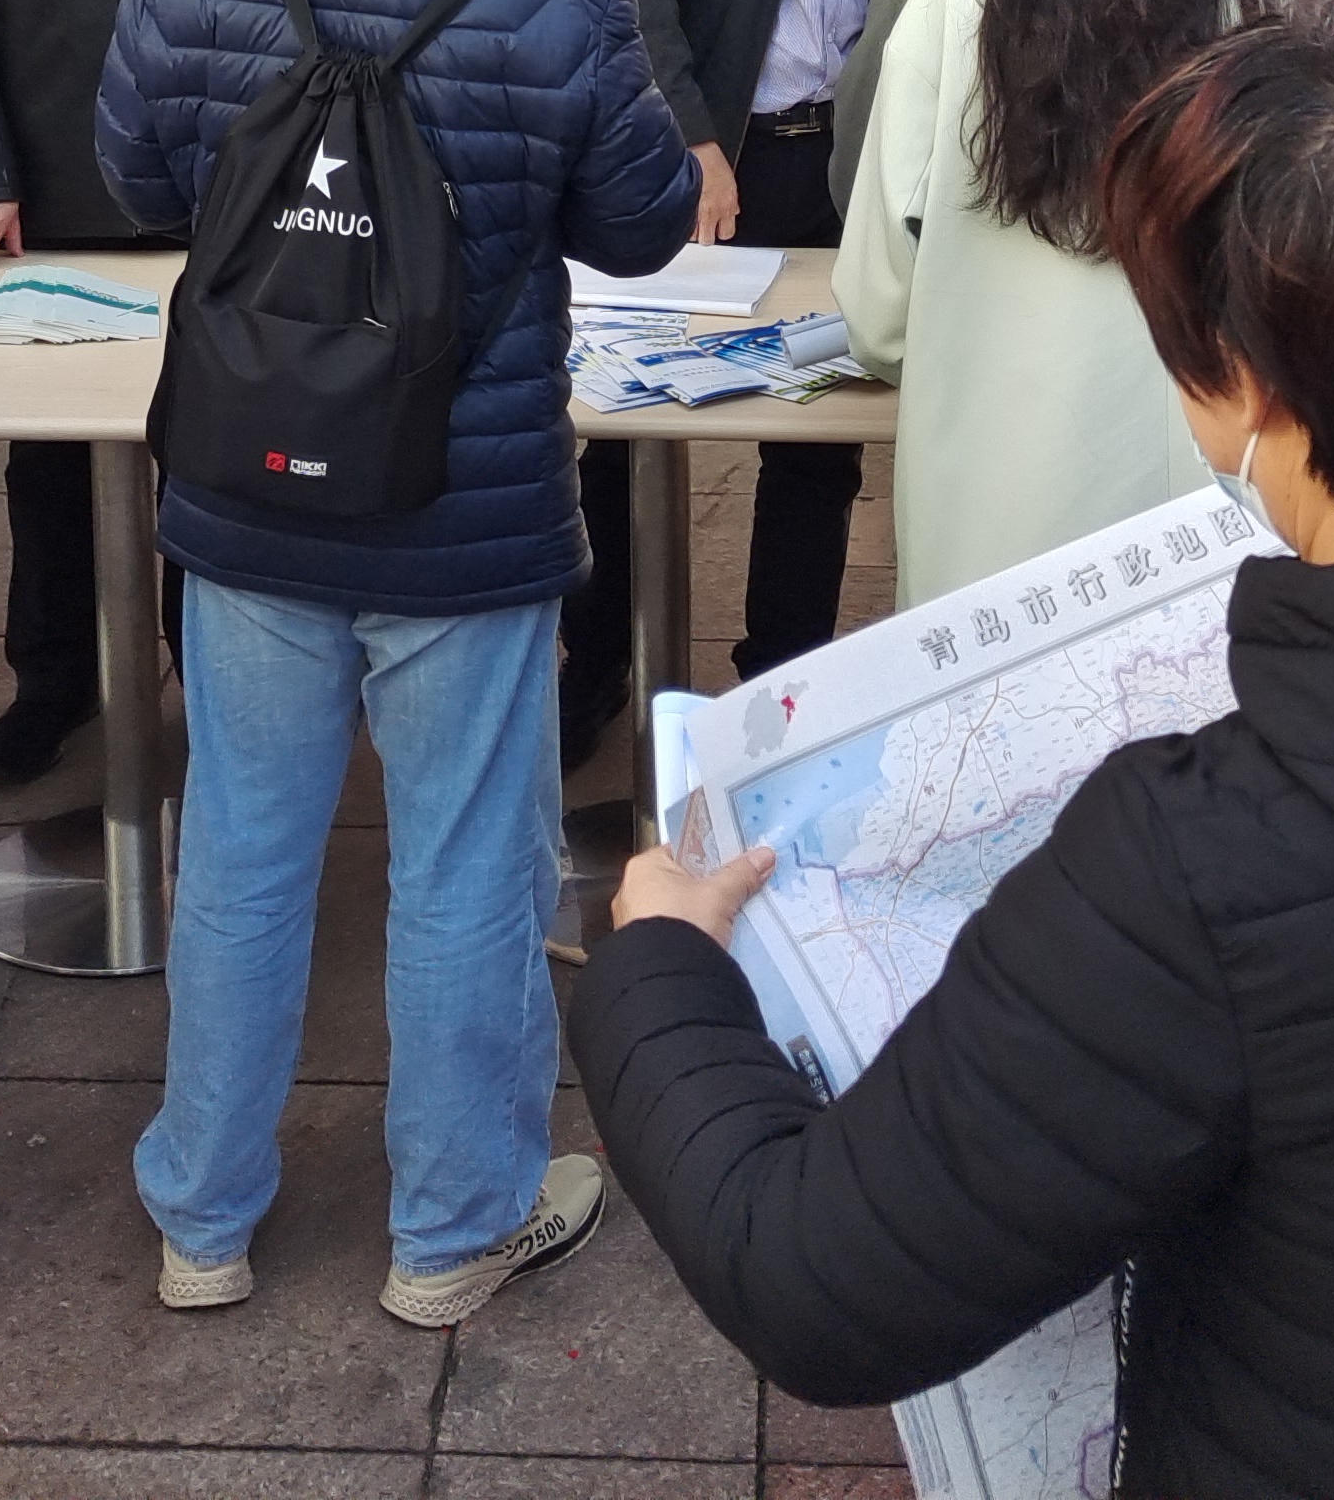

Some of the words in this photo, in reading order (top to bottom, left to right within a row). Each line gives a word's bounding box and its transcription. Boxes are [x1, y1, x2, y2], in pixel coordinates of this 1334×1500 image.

[918, 504, 1255, 670] 青岛市行政地图
